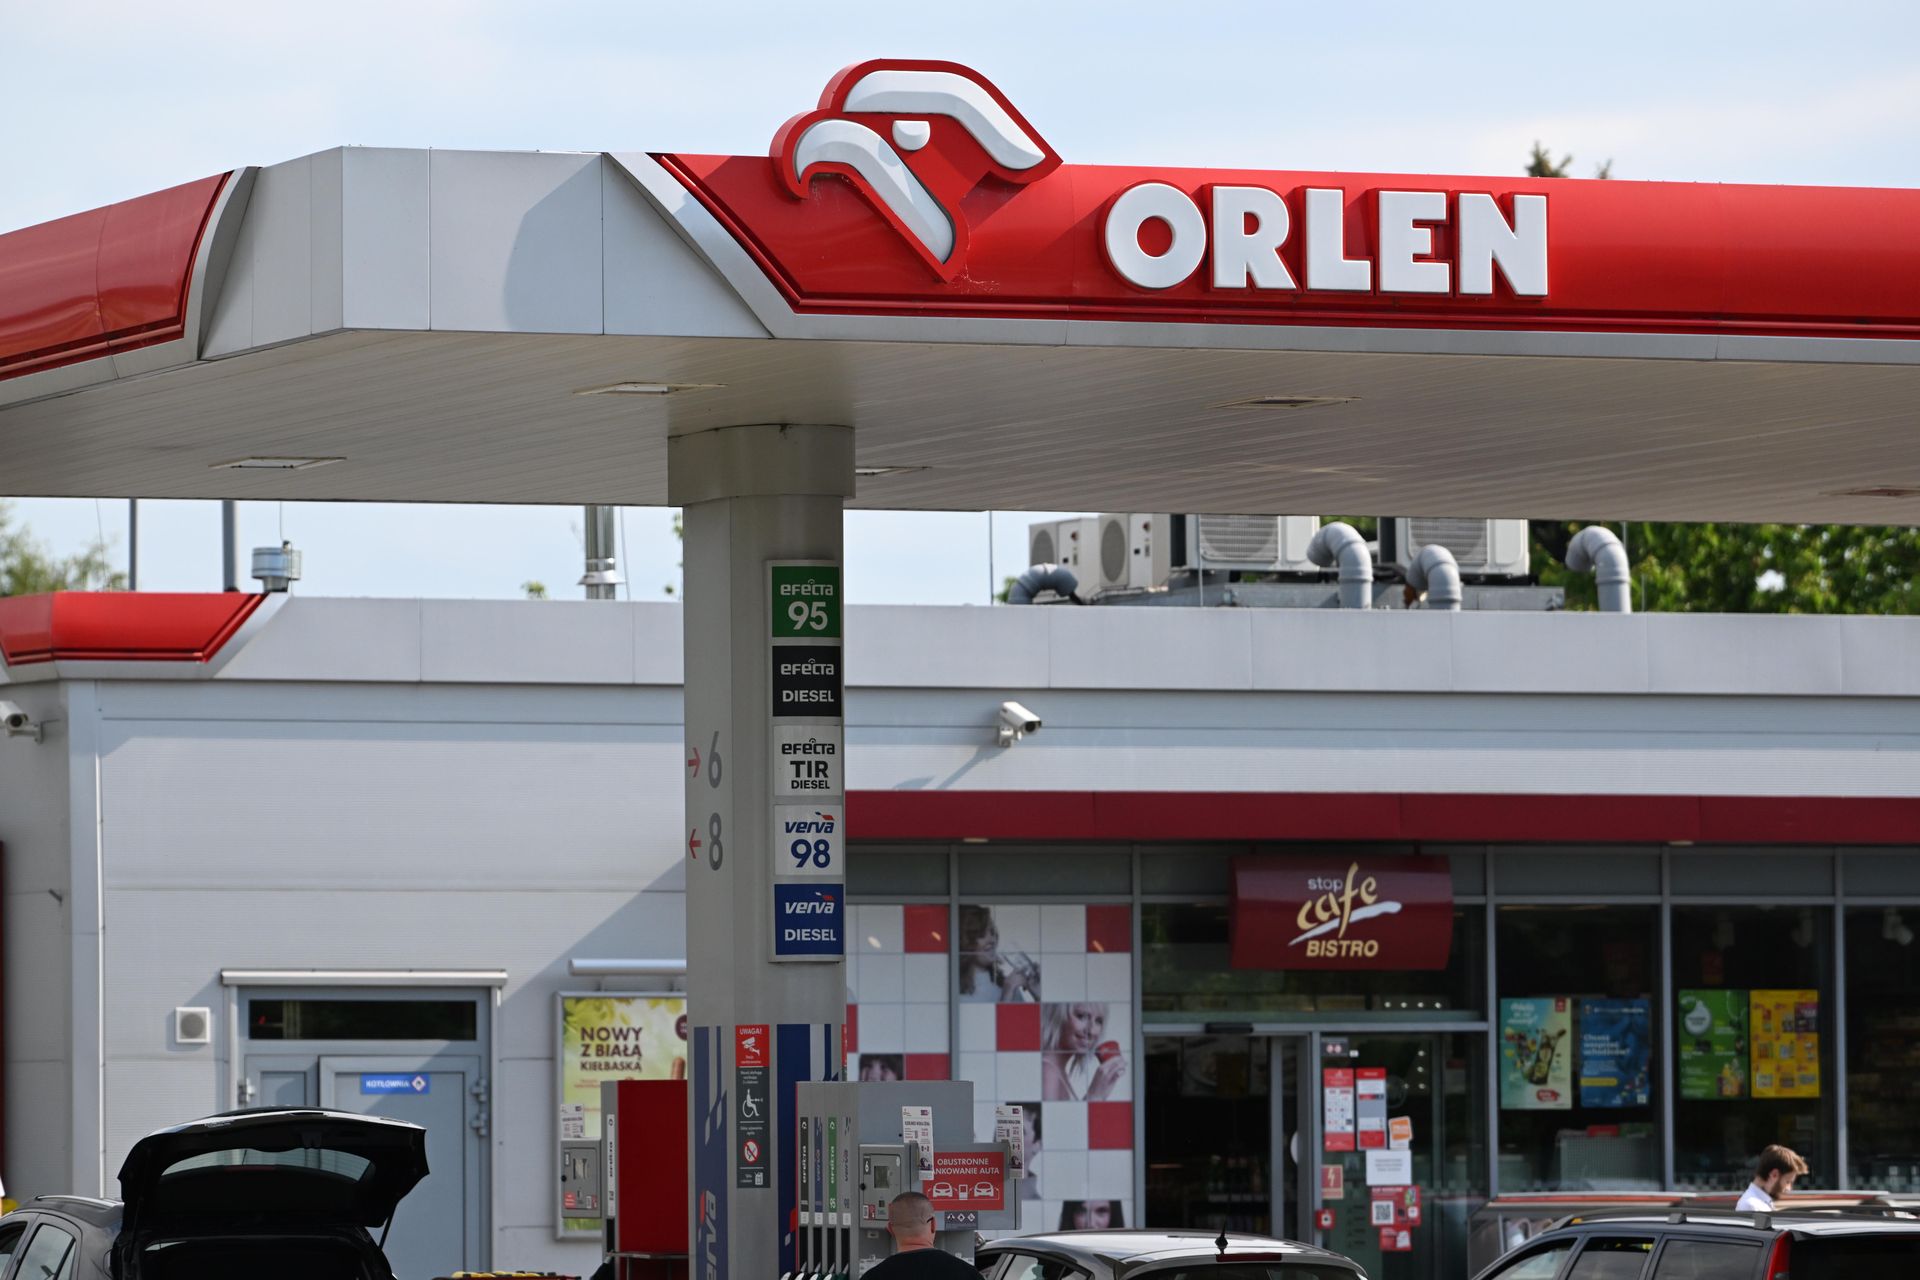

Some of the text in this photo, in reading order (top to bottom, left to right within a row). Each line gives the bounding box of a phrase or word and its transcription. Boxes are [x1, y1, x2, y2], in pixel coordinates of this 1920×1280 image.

[1105, 182, 1548, 296] ORLEN
[788, 601, 828, 631] 95
[782, 690, 835, 702] DIESEL
[708, 731, 722, 788] 6
[790, 760, 829, 778] TIR
[790, 780, 830, 789] DIESEL
[784, 820, 835, 834] verva
[709, 812, 723, 871] 8
[790, 838, 831, 868] 98
[1307, 876, 1344, 893] stop
[784, 900, 835, 914] verva
[1297, 861, 1378, 939] cafe
[784, 928, 836, 941] DIESEL
[1305, 940, 1379, 957] BISTRO
[581, 1026, 643, 1041] NOWY
[739, 1027, 763, 1035] UWAGA!
[581, 1043, 642, 1060] Z BIAŁĄ
[581, 1061, 642, 1073] KIEŁBASKĄ
[365, 1079, 410, 1088] KOTŁOWNIA
[937, 1158, 990, 1166] OBUSTRONNE
[931, 1167, 1000, 1175] ANKOWANIE AUTA
[705, 1190, 717, 1280] erva
